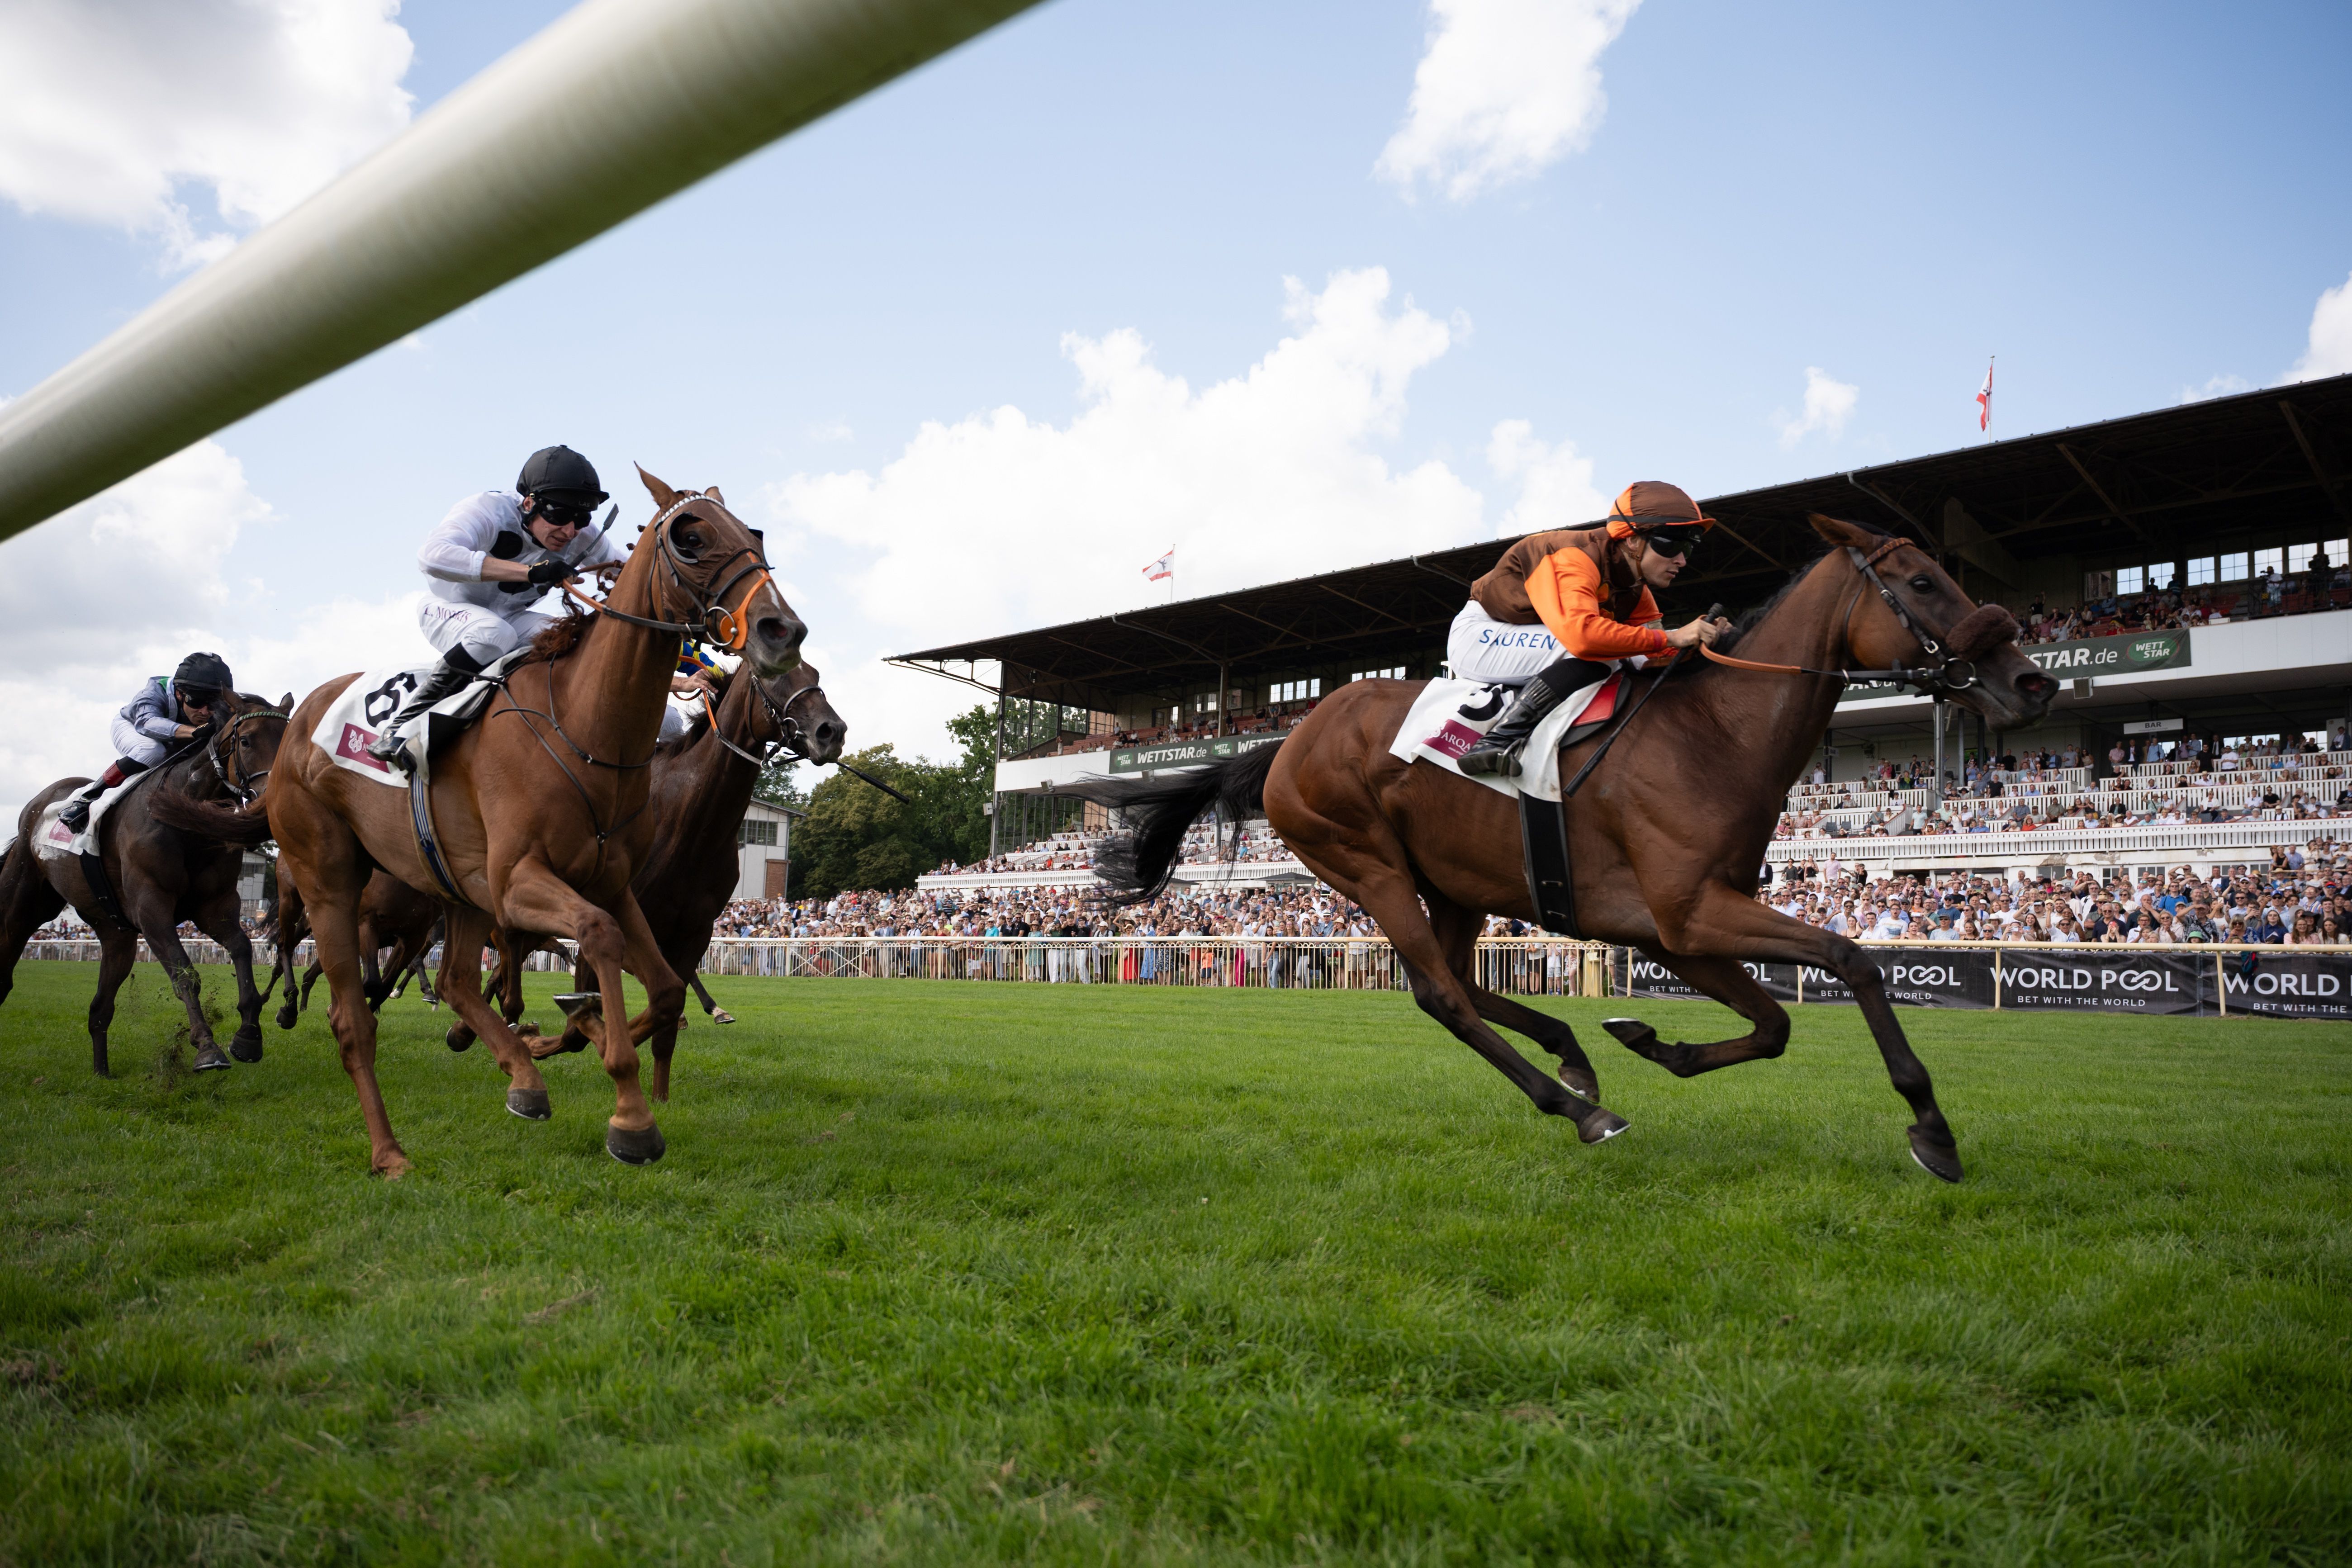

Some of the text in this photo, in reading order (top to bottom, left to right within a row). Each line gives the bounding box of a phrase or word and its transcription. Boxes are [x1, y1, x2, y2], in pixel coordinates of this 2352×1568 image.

[1479, 629, 1556, 650] SAUREN
[2136, 641, 2165, 652] WETT
[2025, 648, 2118, 669] STAR.de
[2143, 648, 2170, 658] STAR
[1441, 732, 1471, 753] ARQA
[1137, 747, 1207, 764] WETTSTAR.de
[1893, 965, 1961, 986] POOL
[1990, 967, 2179, 991] WORLD POOL
[2222, 972, 2340, 996] WORLD
[1895, 992, 1932, 1000] WORLD
[2103, 999, 2145, 1007] WORLD
[2283, 1004, 2316, 1012] WITH
[2321, 1005, 2347, 1013] THE
